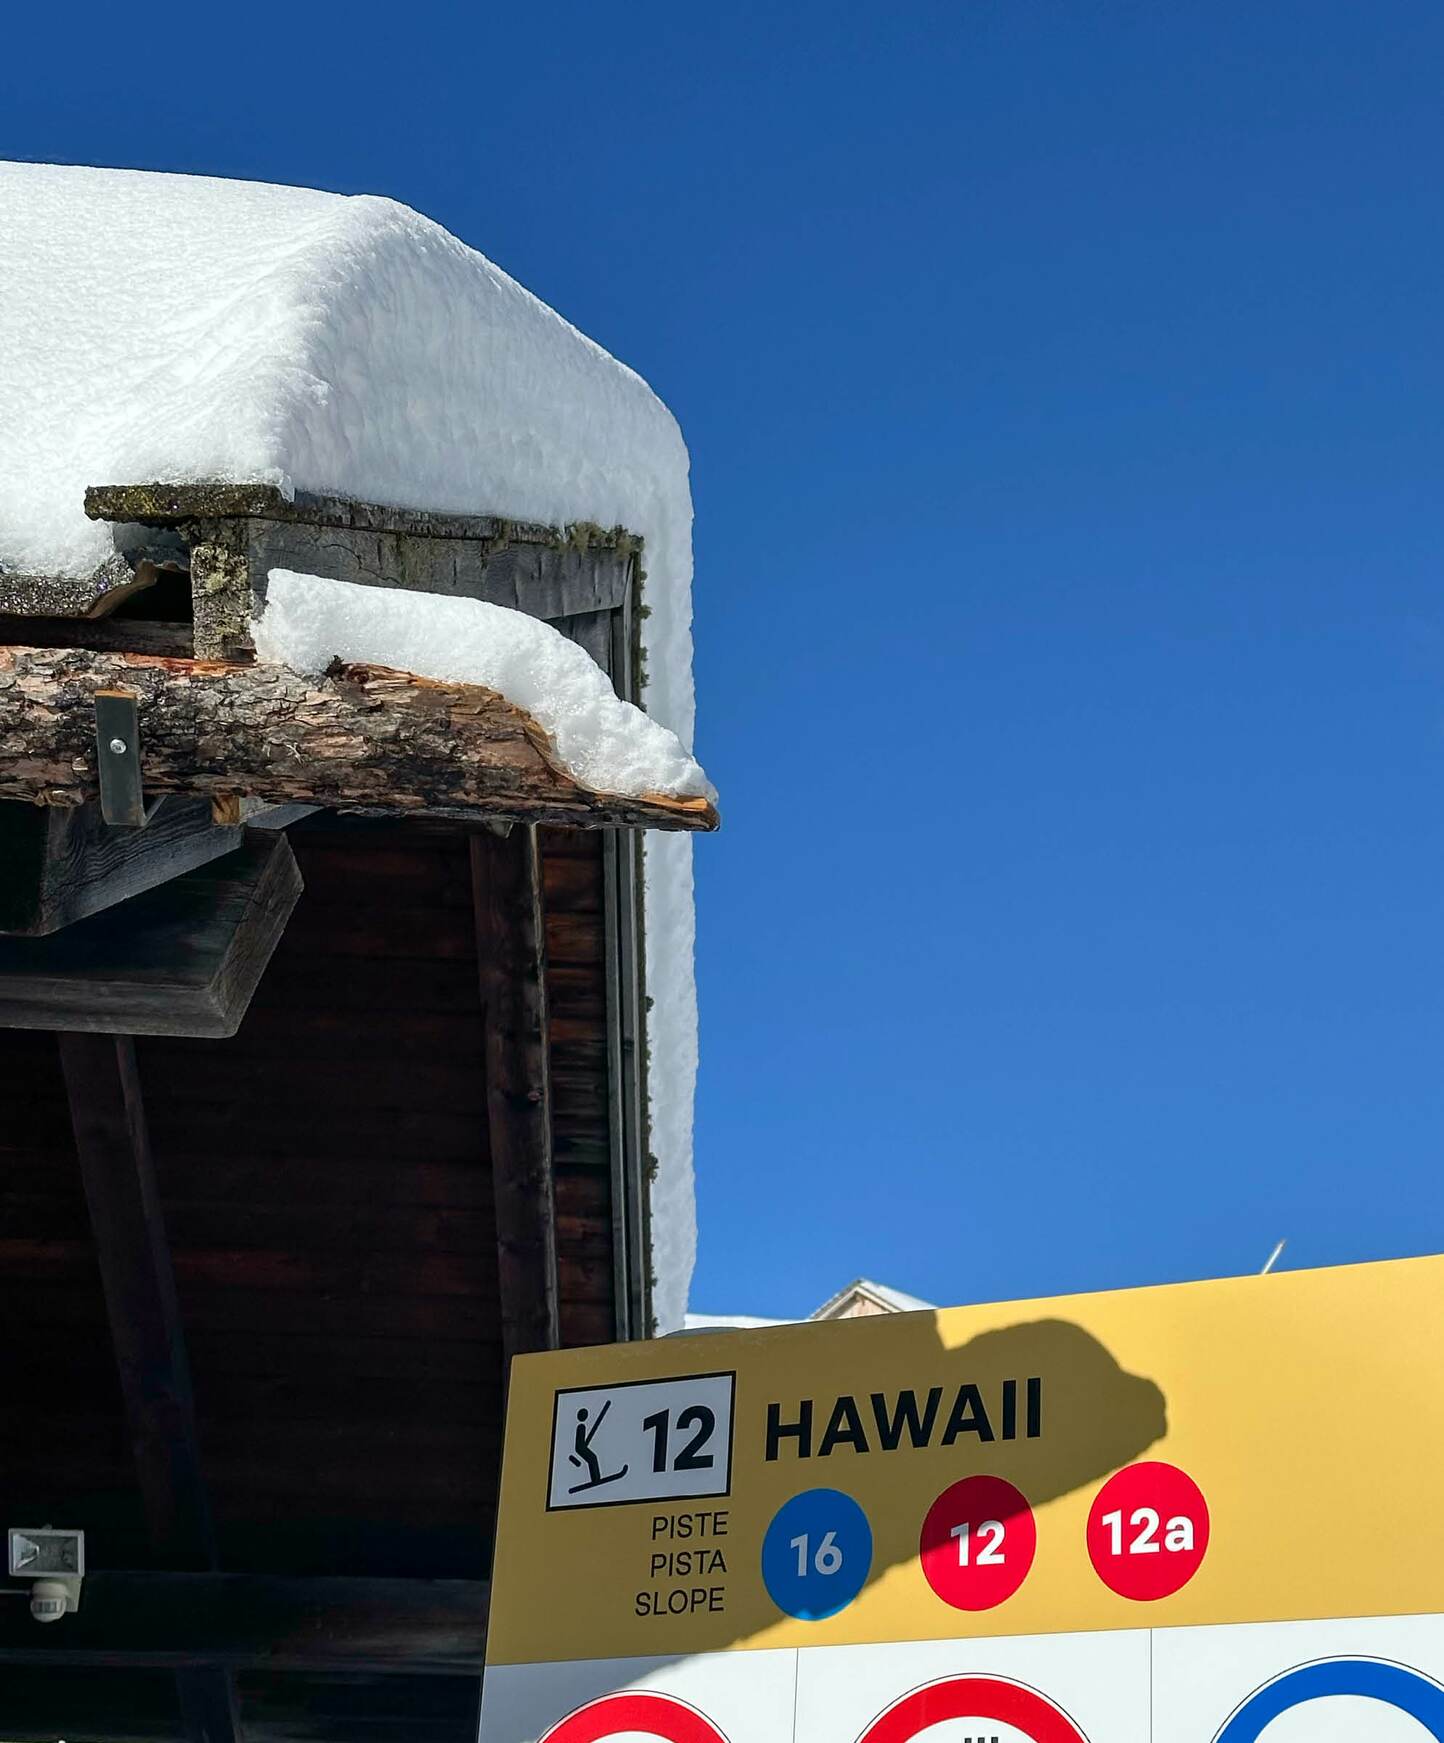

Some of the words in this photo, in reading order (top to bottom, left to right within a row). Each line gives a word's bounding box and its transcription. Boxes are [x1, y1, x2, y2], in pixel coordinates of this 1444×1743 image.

[642, 1405, 716, 1473] 12
[765, 1377, 1041, 1461] HAWAII
[651, 1511, 729, 1541] PISTE
[950, 1519, 1006, 1567] 12
[1101, 1506, 1195, 1556] 12a
[650, 1549, 727, 1579] PISTA
[789, 1531, 842, 1577] 16
[634, 1586, 725, 1617] SLOPE
